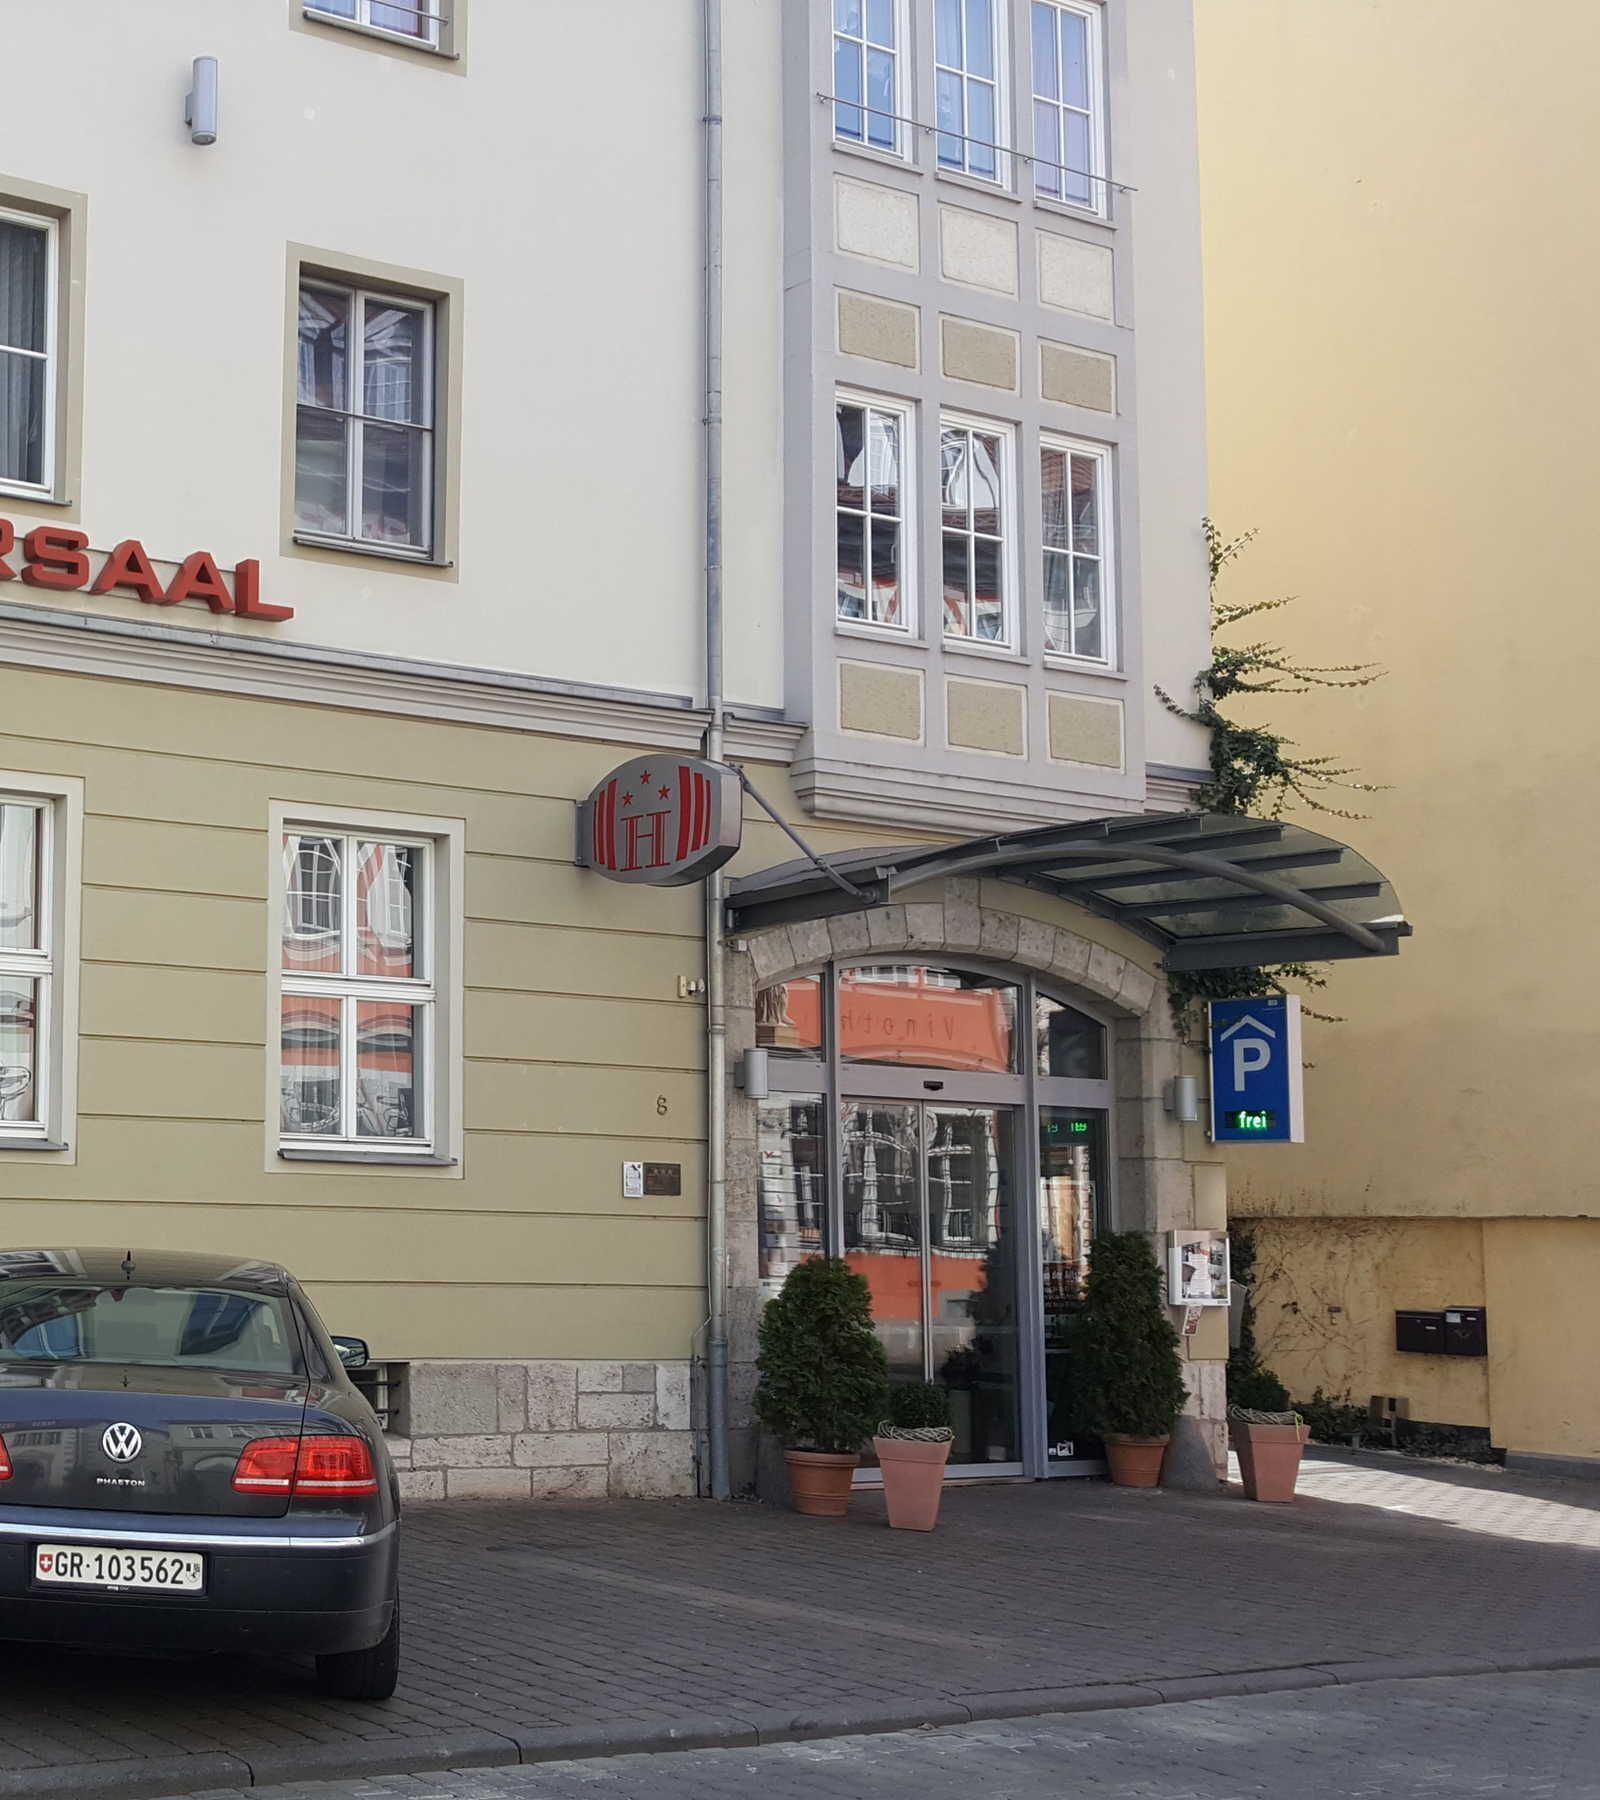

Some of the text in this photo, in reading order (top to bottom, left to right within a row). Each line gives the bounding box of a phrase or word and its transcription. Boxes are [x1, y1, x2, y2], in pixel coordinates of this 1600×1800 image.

[619, 810, 672, 872] H
[1233, 1037, 1271, 1092] P
[1239, 1110, 1268, 1129] frei
[96, 1477, 146, 1487] PHAETON
